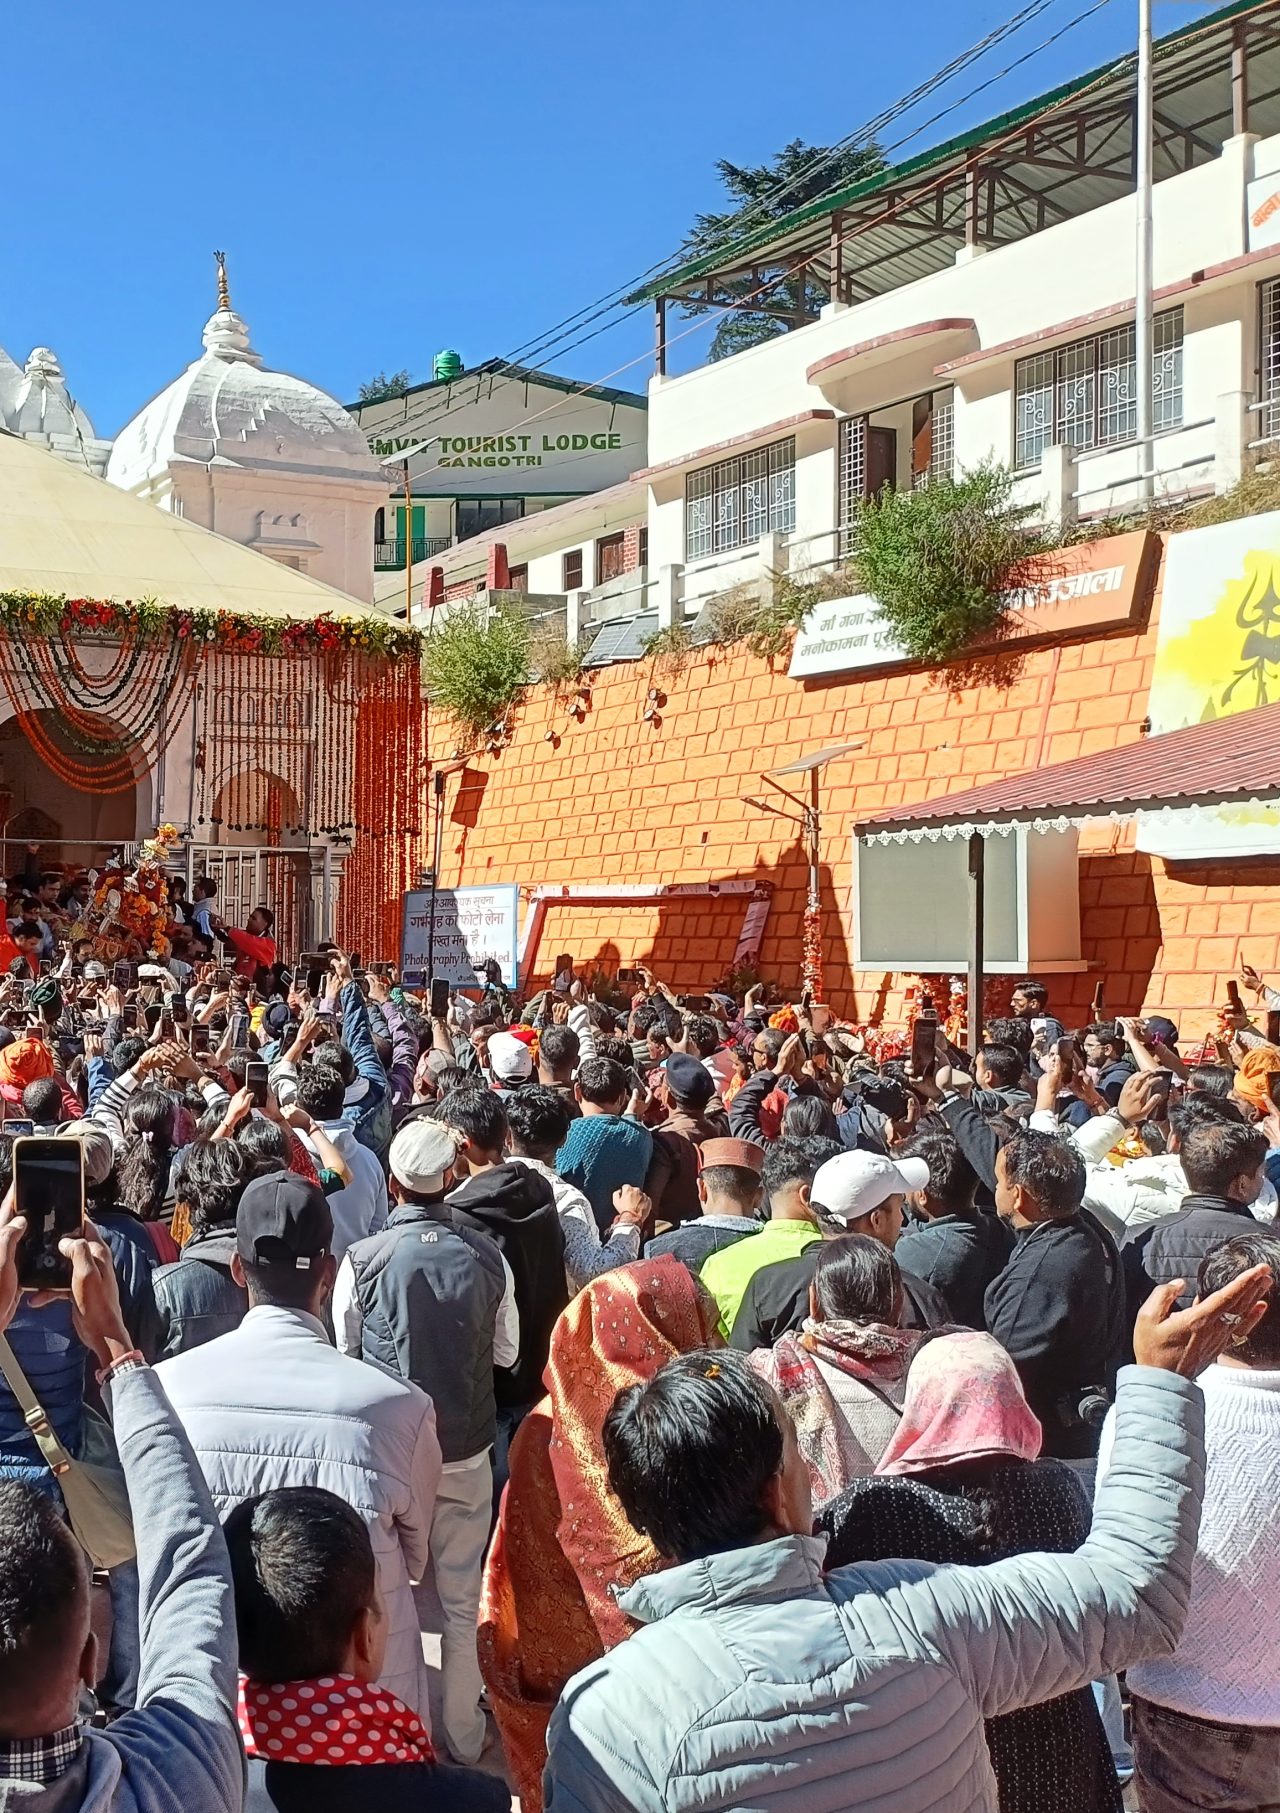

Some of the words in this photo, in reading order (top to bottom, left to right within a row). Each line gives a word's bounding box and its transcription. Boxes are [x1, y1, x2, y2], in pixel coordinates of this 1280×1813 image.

[439, 435, 531, 453] TOURIST
[542, 433, 621, 450] LODGE
[438, 456, 542, 467] GANGOTRI
[839, 611, 865, 627] गंगा
[800, 634, 869, 656] मनोकामना
[473, 896, 494, 908] सूचना
[445, 914, 458, 927] का
[459, 910, 483, 926] फोटो
[485, 909, 504, 925] लेना
[452, 934, 468, 947] मना
[404, 952, 460, 967] Photoraphy
